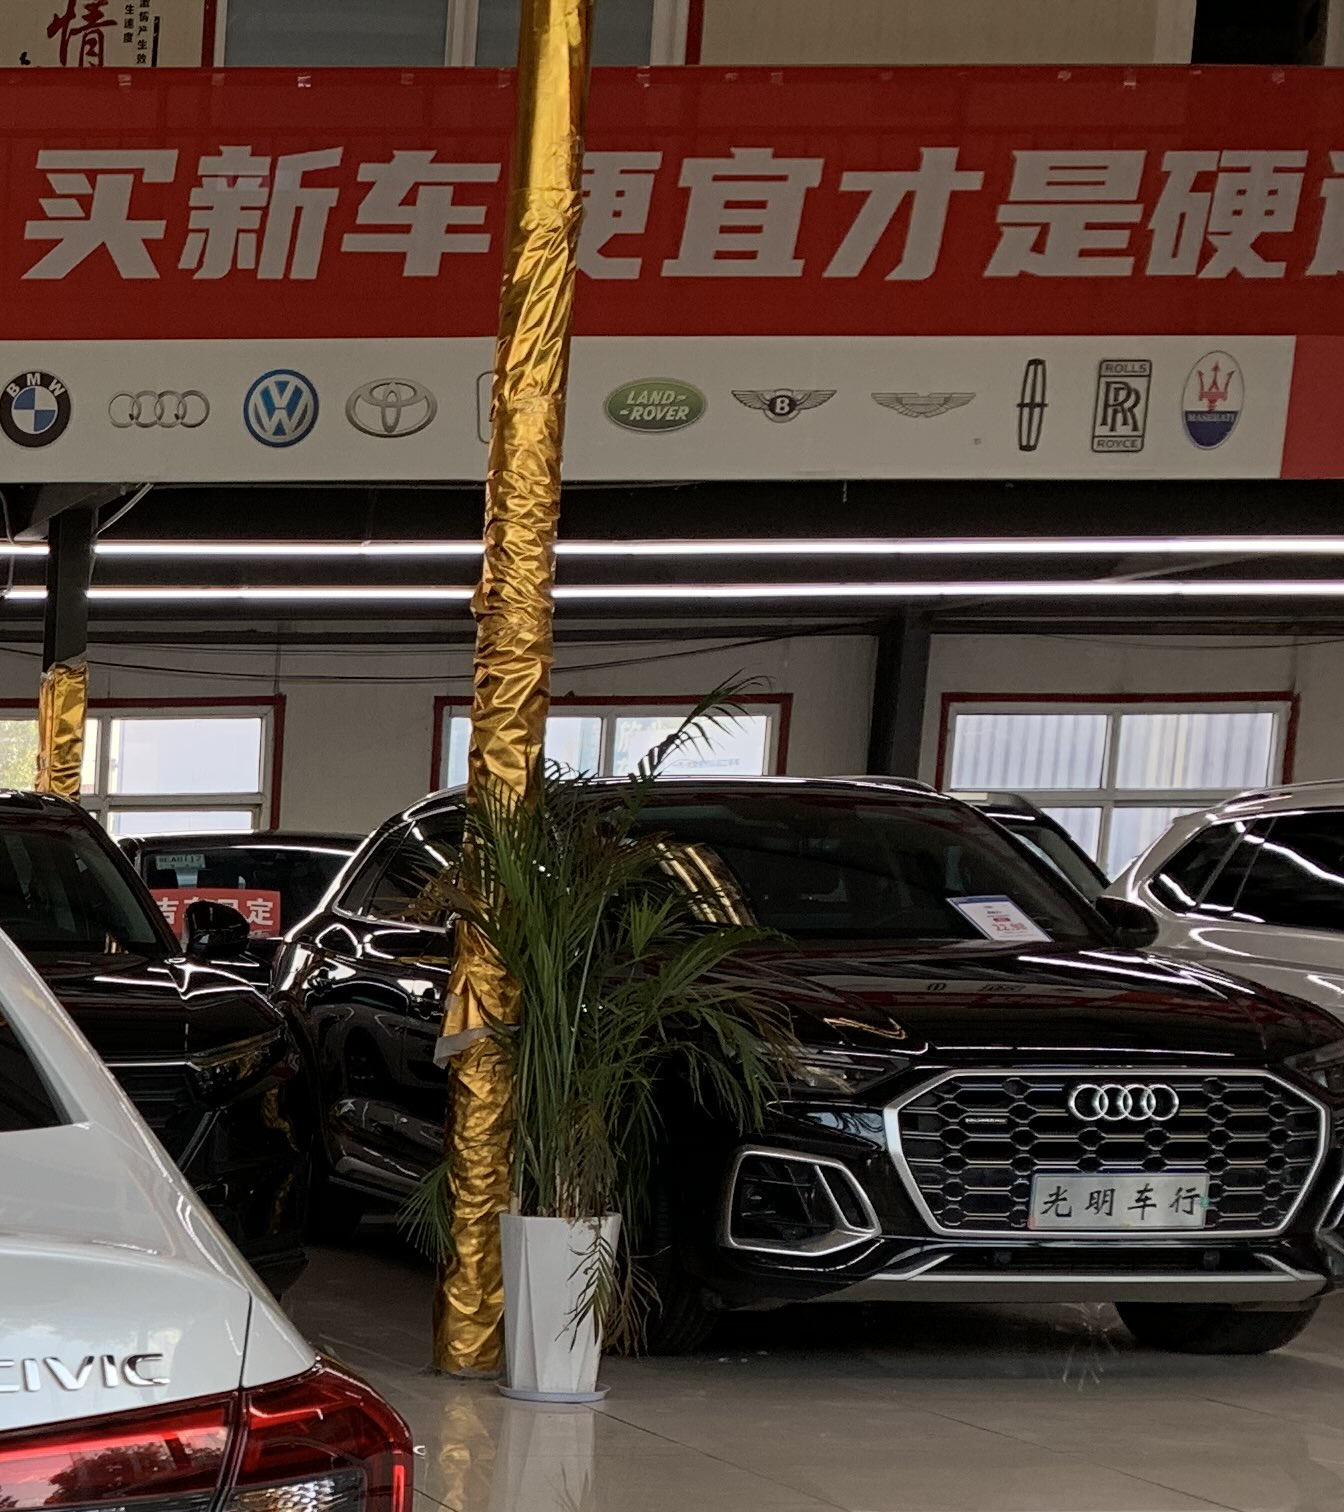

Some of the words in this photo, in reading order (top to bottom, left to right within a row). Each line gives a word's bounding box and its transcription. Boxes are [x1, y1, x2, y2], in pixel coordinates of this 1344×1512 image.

[123, 0, 135, 44] 生速度
[1105, 363, 1148, 375] ROLLS
[5, 372, 66, 398] BMW
[1097, 439, 1139, 449] ROYCE
[1040, 1183, 1200, 1221] 光明车行
